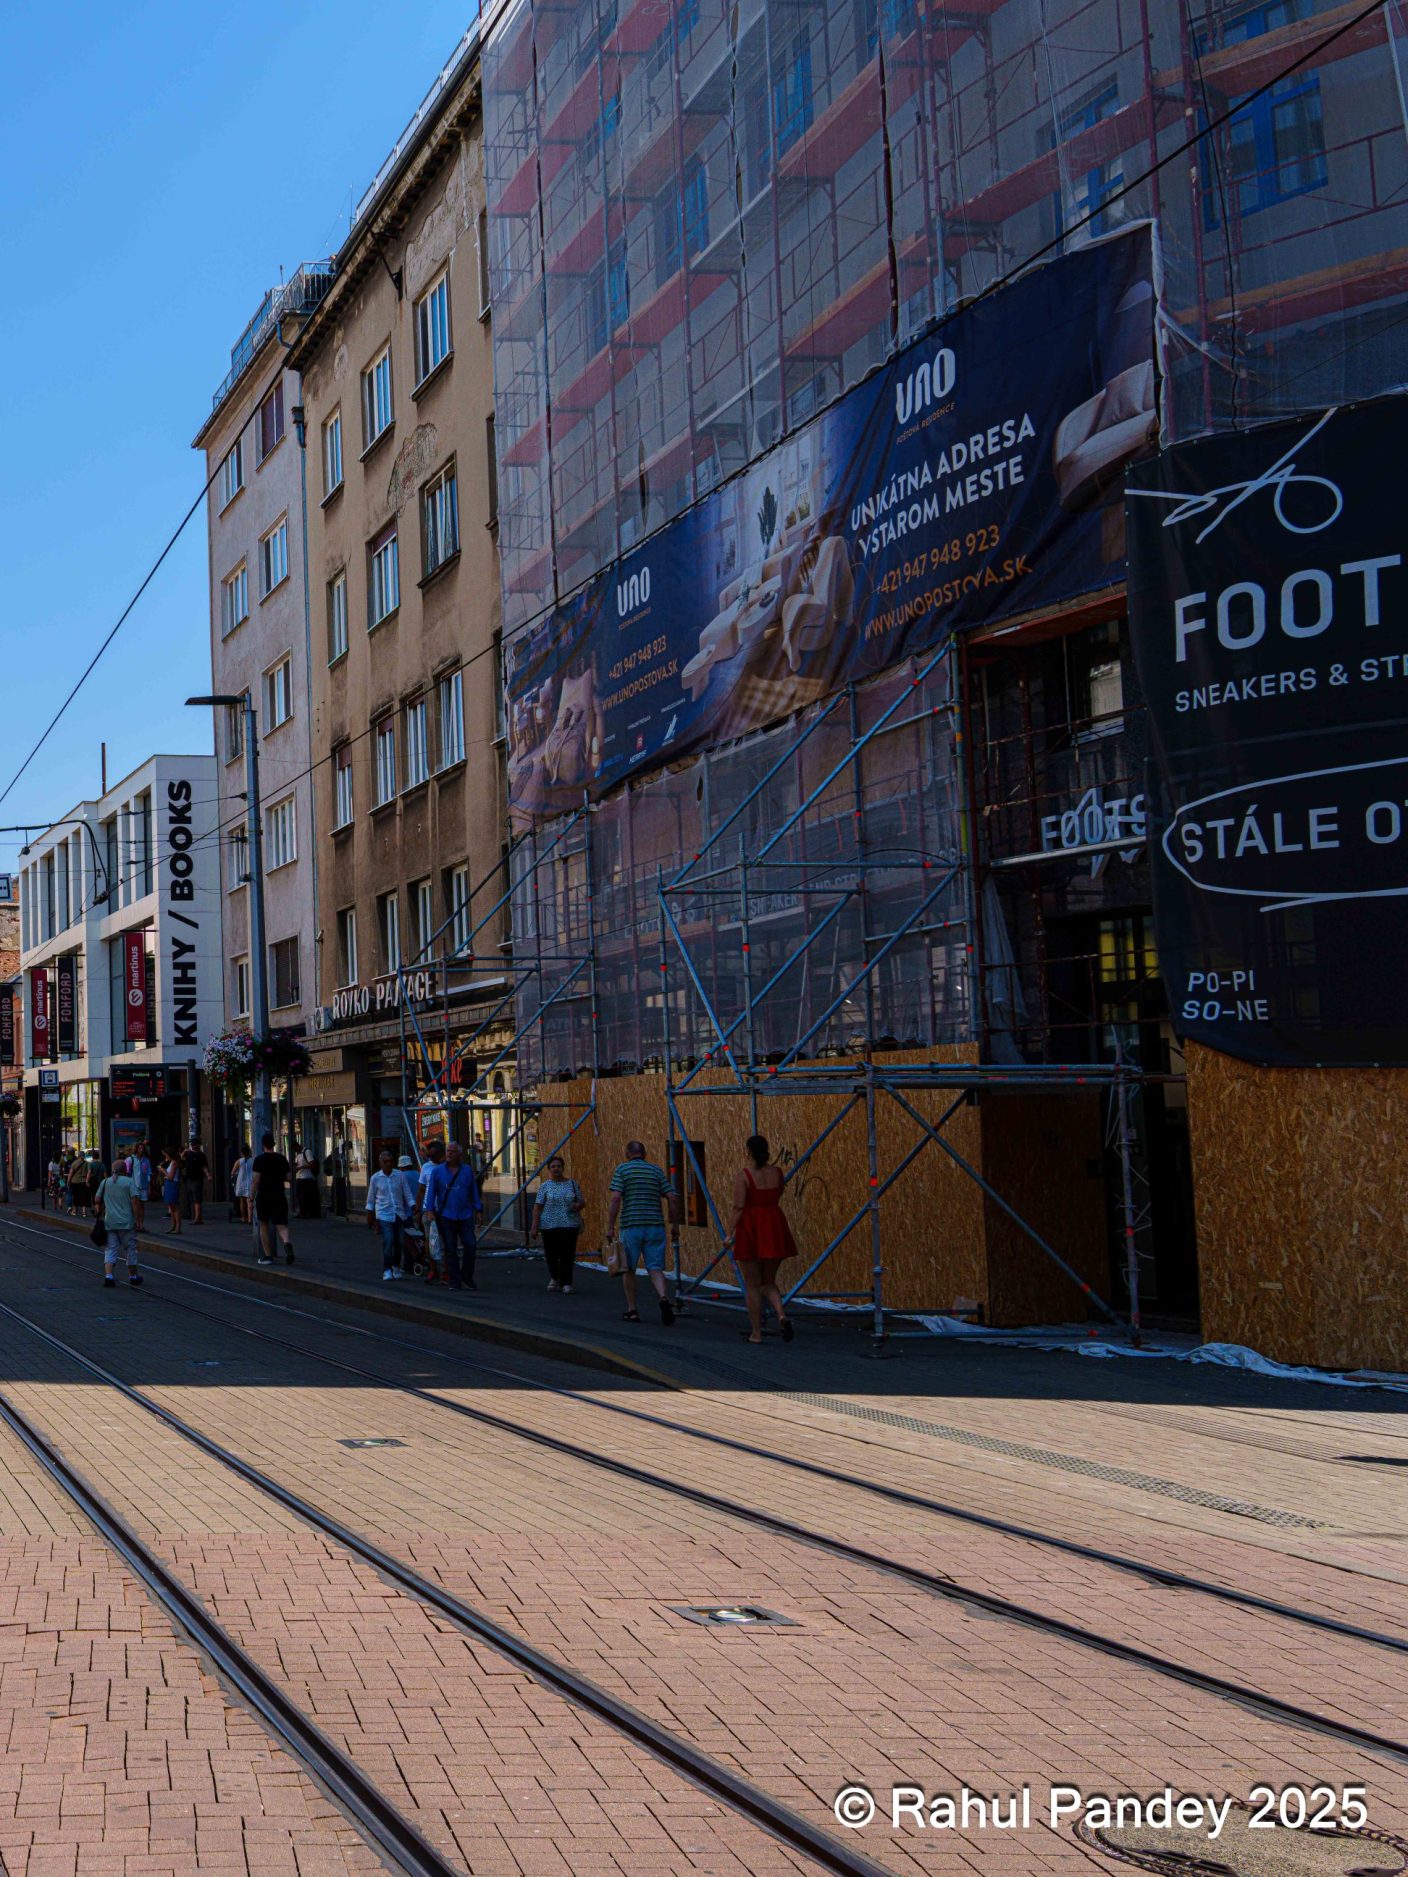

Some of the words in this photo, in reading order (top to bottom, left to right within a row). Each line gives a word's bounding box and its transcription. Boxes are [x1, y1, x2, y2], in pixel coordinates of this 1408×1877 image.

[895, 348, 956, 425] UNO
[851, 460, 933, 531] UNIKÁTNA
[936, 412, 1036, 480] ADRESA
[945, 454, 1025, 513] MESTE
[903, 553, 927, 584] 947
[930, 539, 961, 570] 948
[965, 524, 1000, 556] 923
[617, 566, 651, 617] UNO
[1174, 554, 1401, 663] FOOT
[624, 652, 637, 673] 947
[653, 634, 667, 657] 923
[1175, 667, 1317, 713] SNEAKERS
[1328, 663, 1350, 686] &
[1359, 653, 1408, 682] ST
[168, 779, 194, 901] BOOKS
[1181, 803, 1341, 864] STÁLE
[1365, 798, 1408, 845] O
[130, 945, 140, 987] martinus
[172, 937, 198, 1046] KNIHY
[1187, 969, 1256, 993] PO-PI
[36, 980, 44, 1014] martinus
[332, 985, 370, 1020] ROYKO
[1182, 999, 1270, 1022] SO-NE
